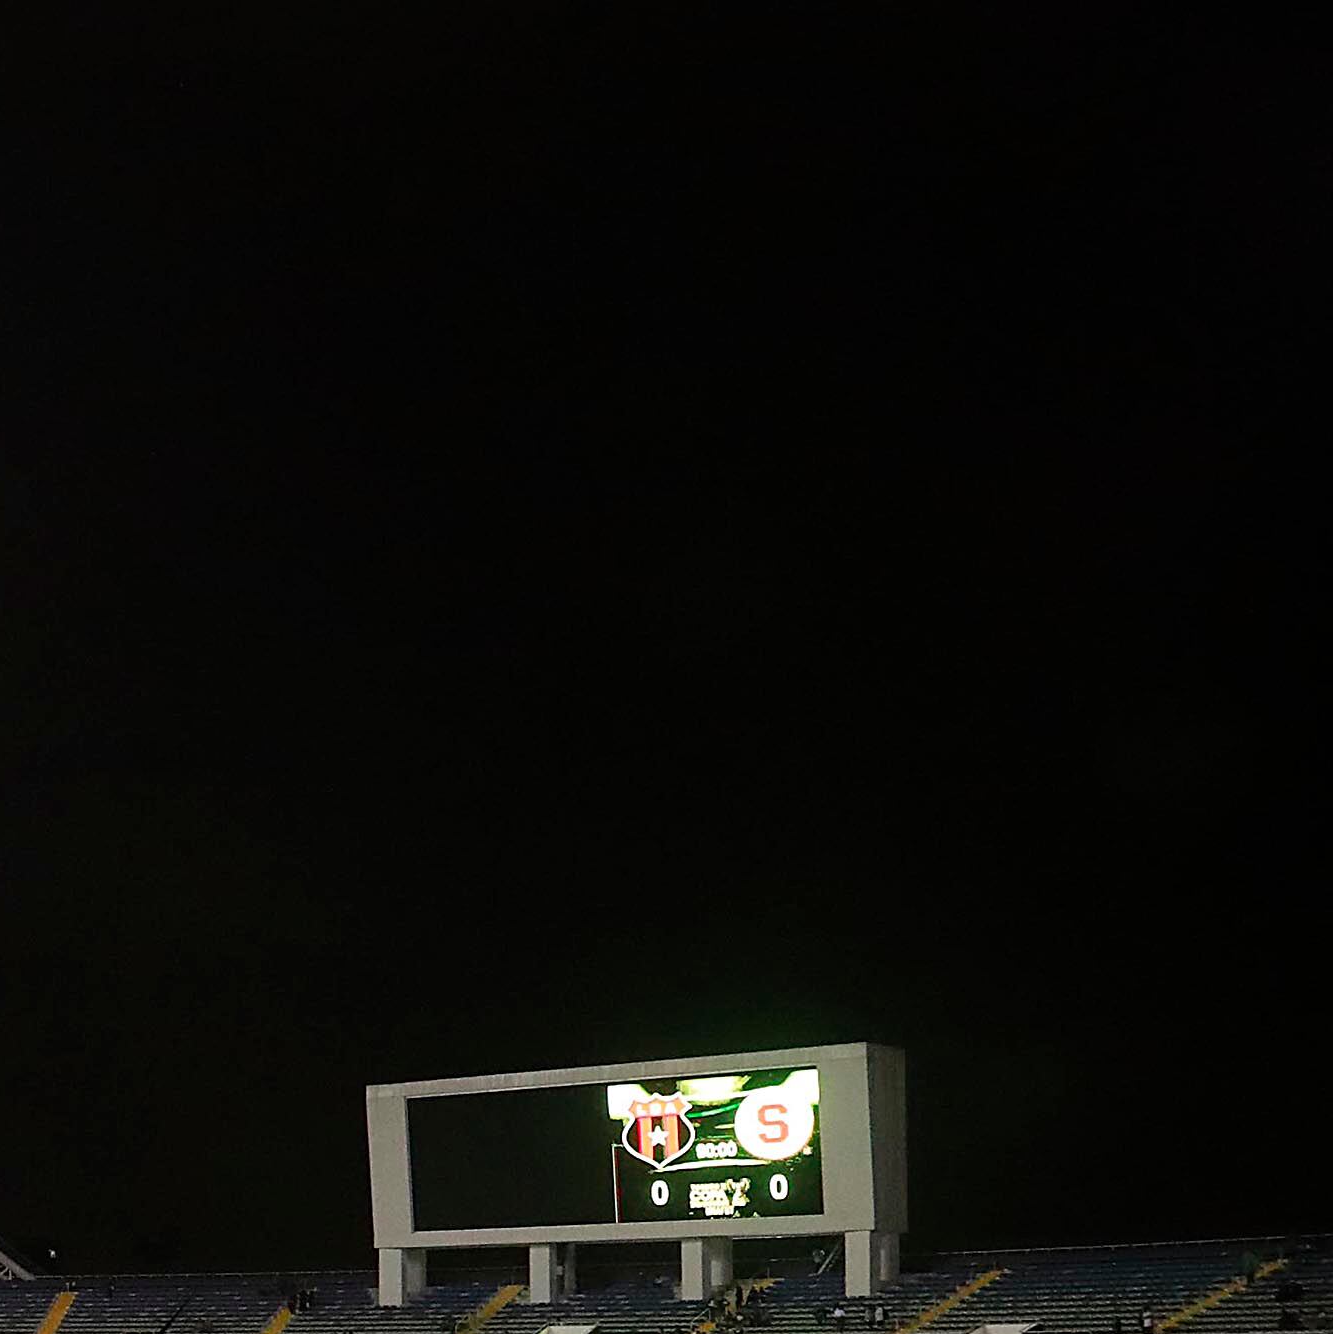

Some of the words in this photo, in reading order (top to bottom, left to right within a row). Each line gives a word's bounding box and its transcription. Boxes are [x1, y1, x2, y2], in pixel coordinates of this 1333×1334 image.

[757, 1104, 789, 1143] S
[650, 1180, 670, 1206] 0
[769, 1174, 789, 1200] 0
